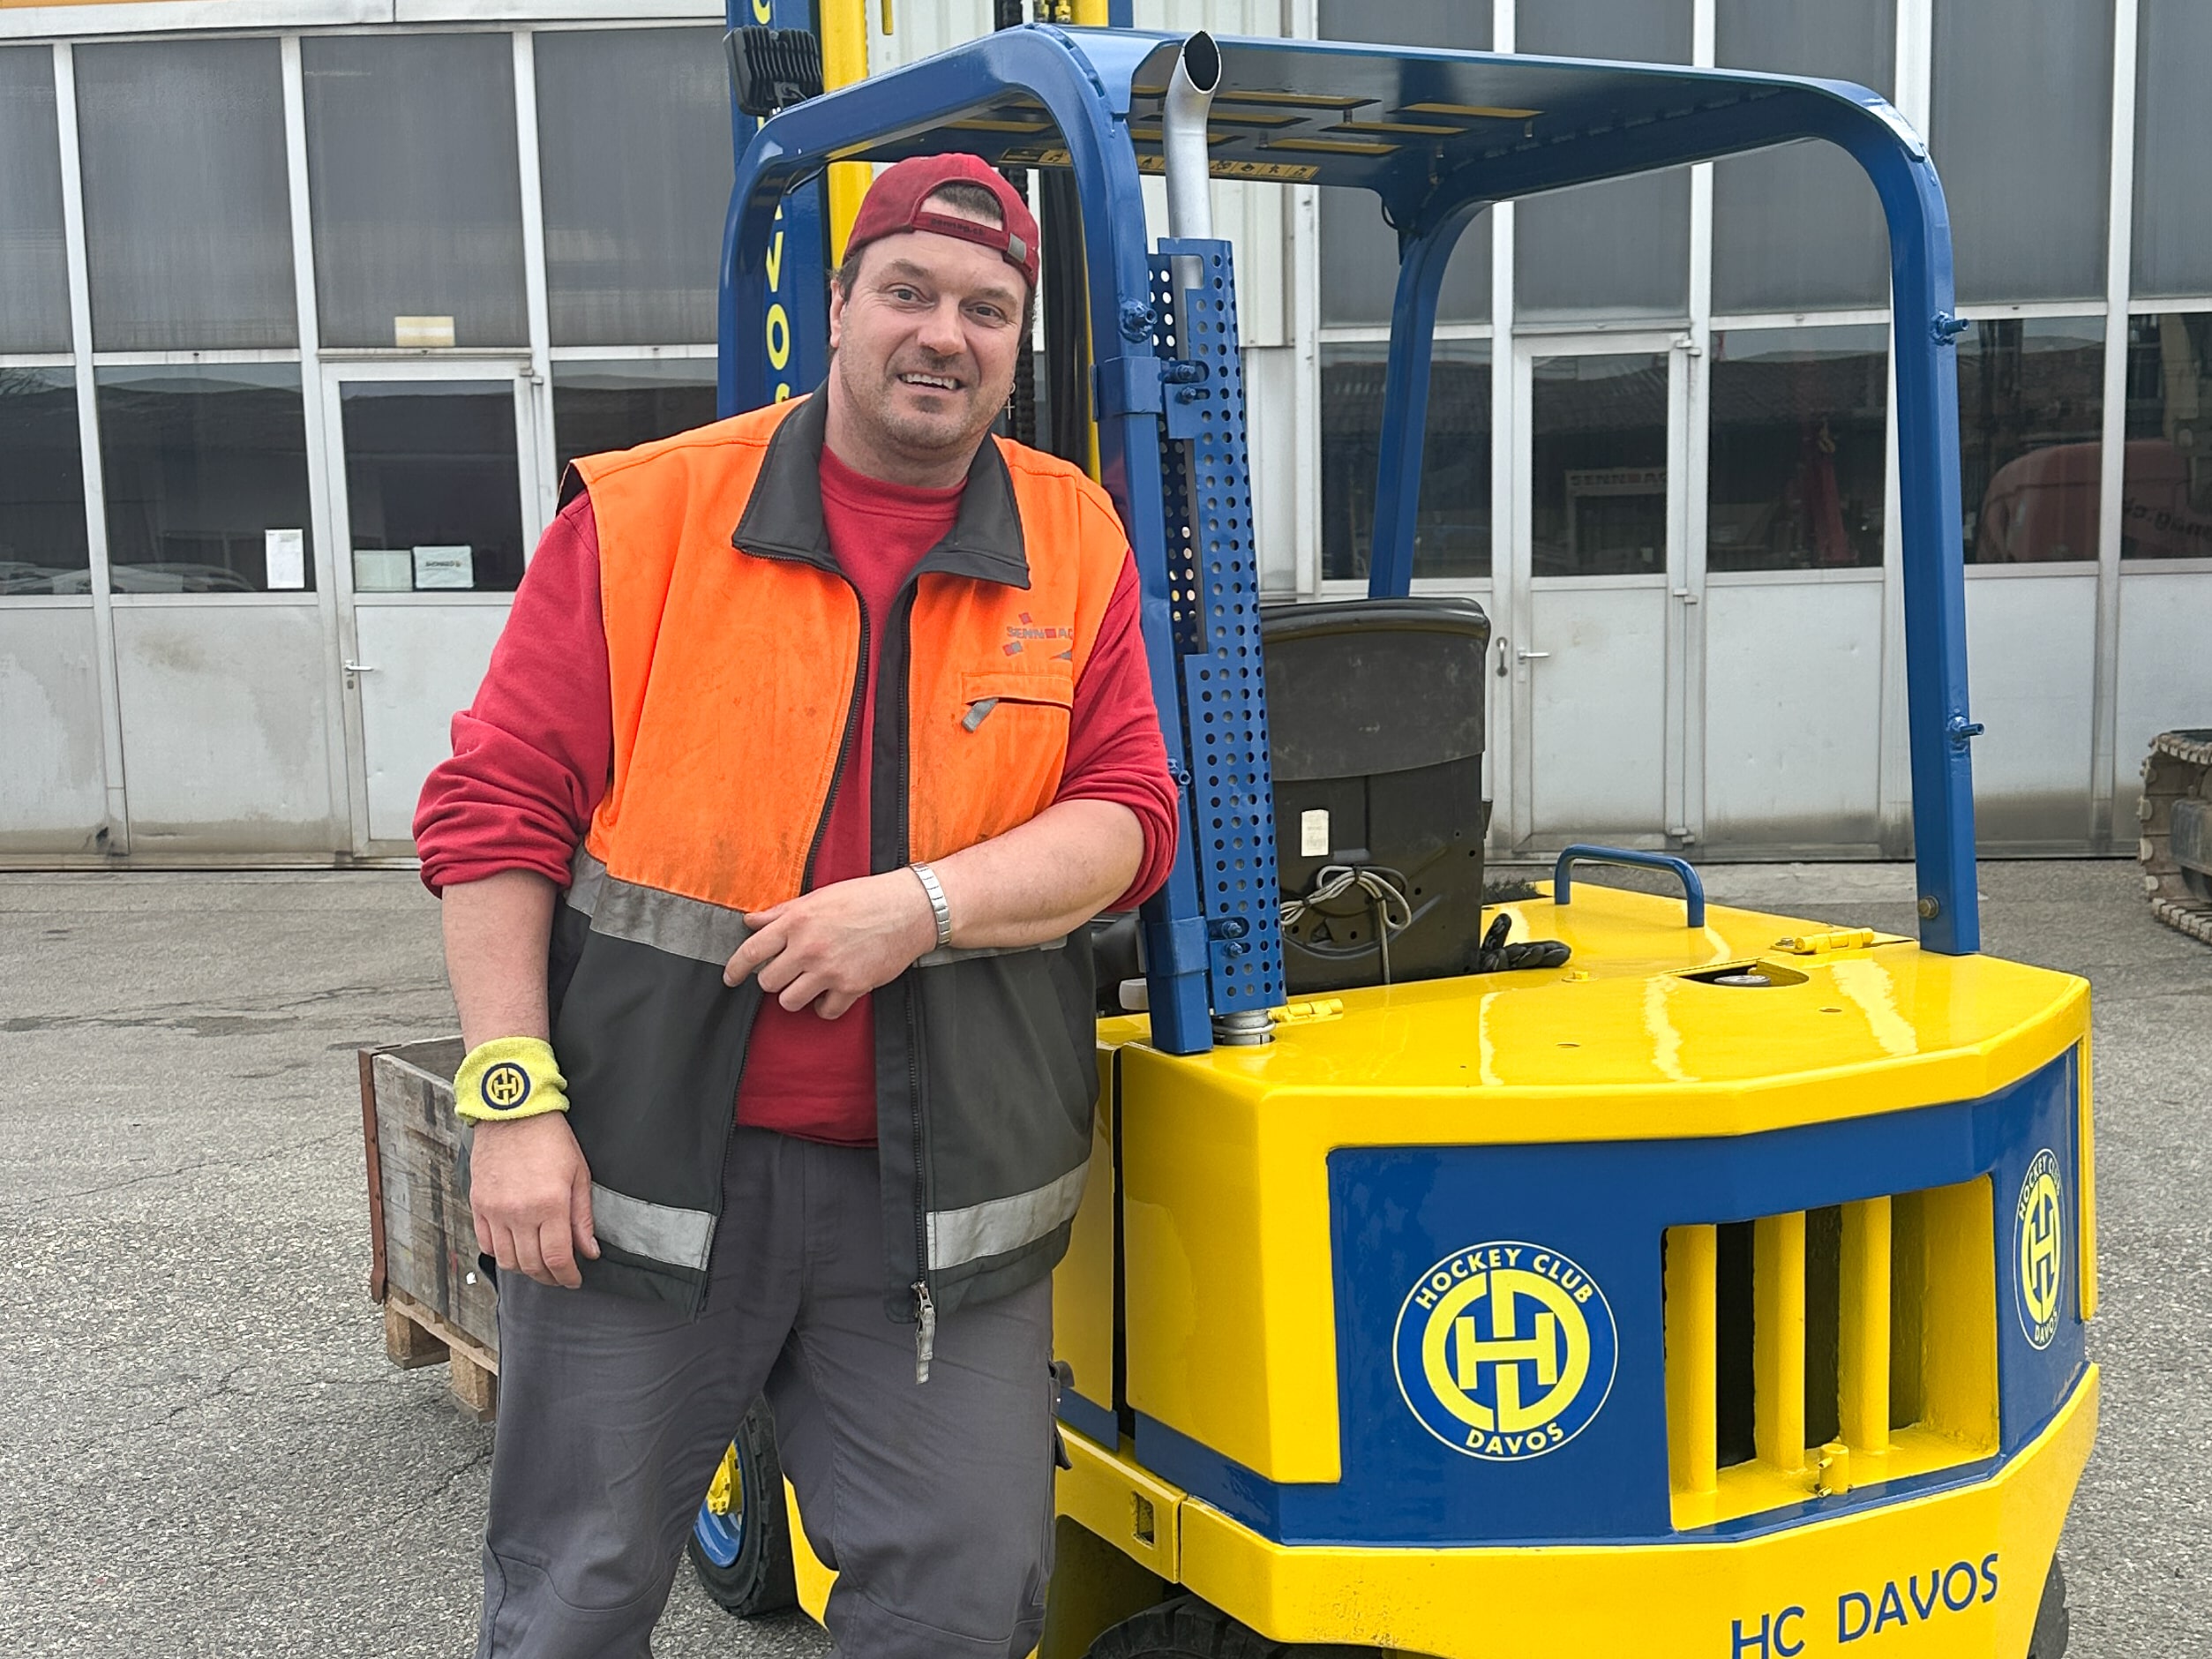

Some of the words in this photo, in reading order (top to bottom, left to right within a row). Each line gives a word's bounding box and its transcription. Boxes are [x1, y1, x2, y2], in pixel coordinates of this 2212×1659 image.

[2018, 1154, 2047, 1221] HOCKEY
[1414, 1248, 1522, 1310] HOCKEY
[1533, 1254, 1594, 1304] CLUB
[1465, 1422, 1564, 1455] DAVOS
[1731, 1605, 1805, 1659] HC
[1838, 1553, 1998, 1644] DAVOS
